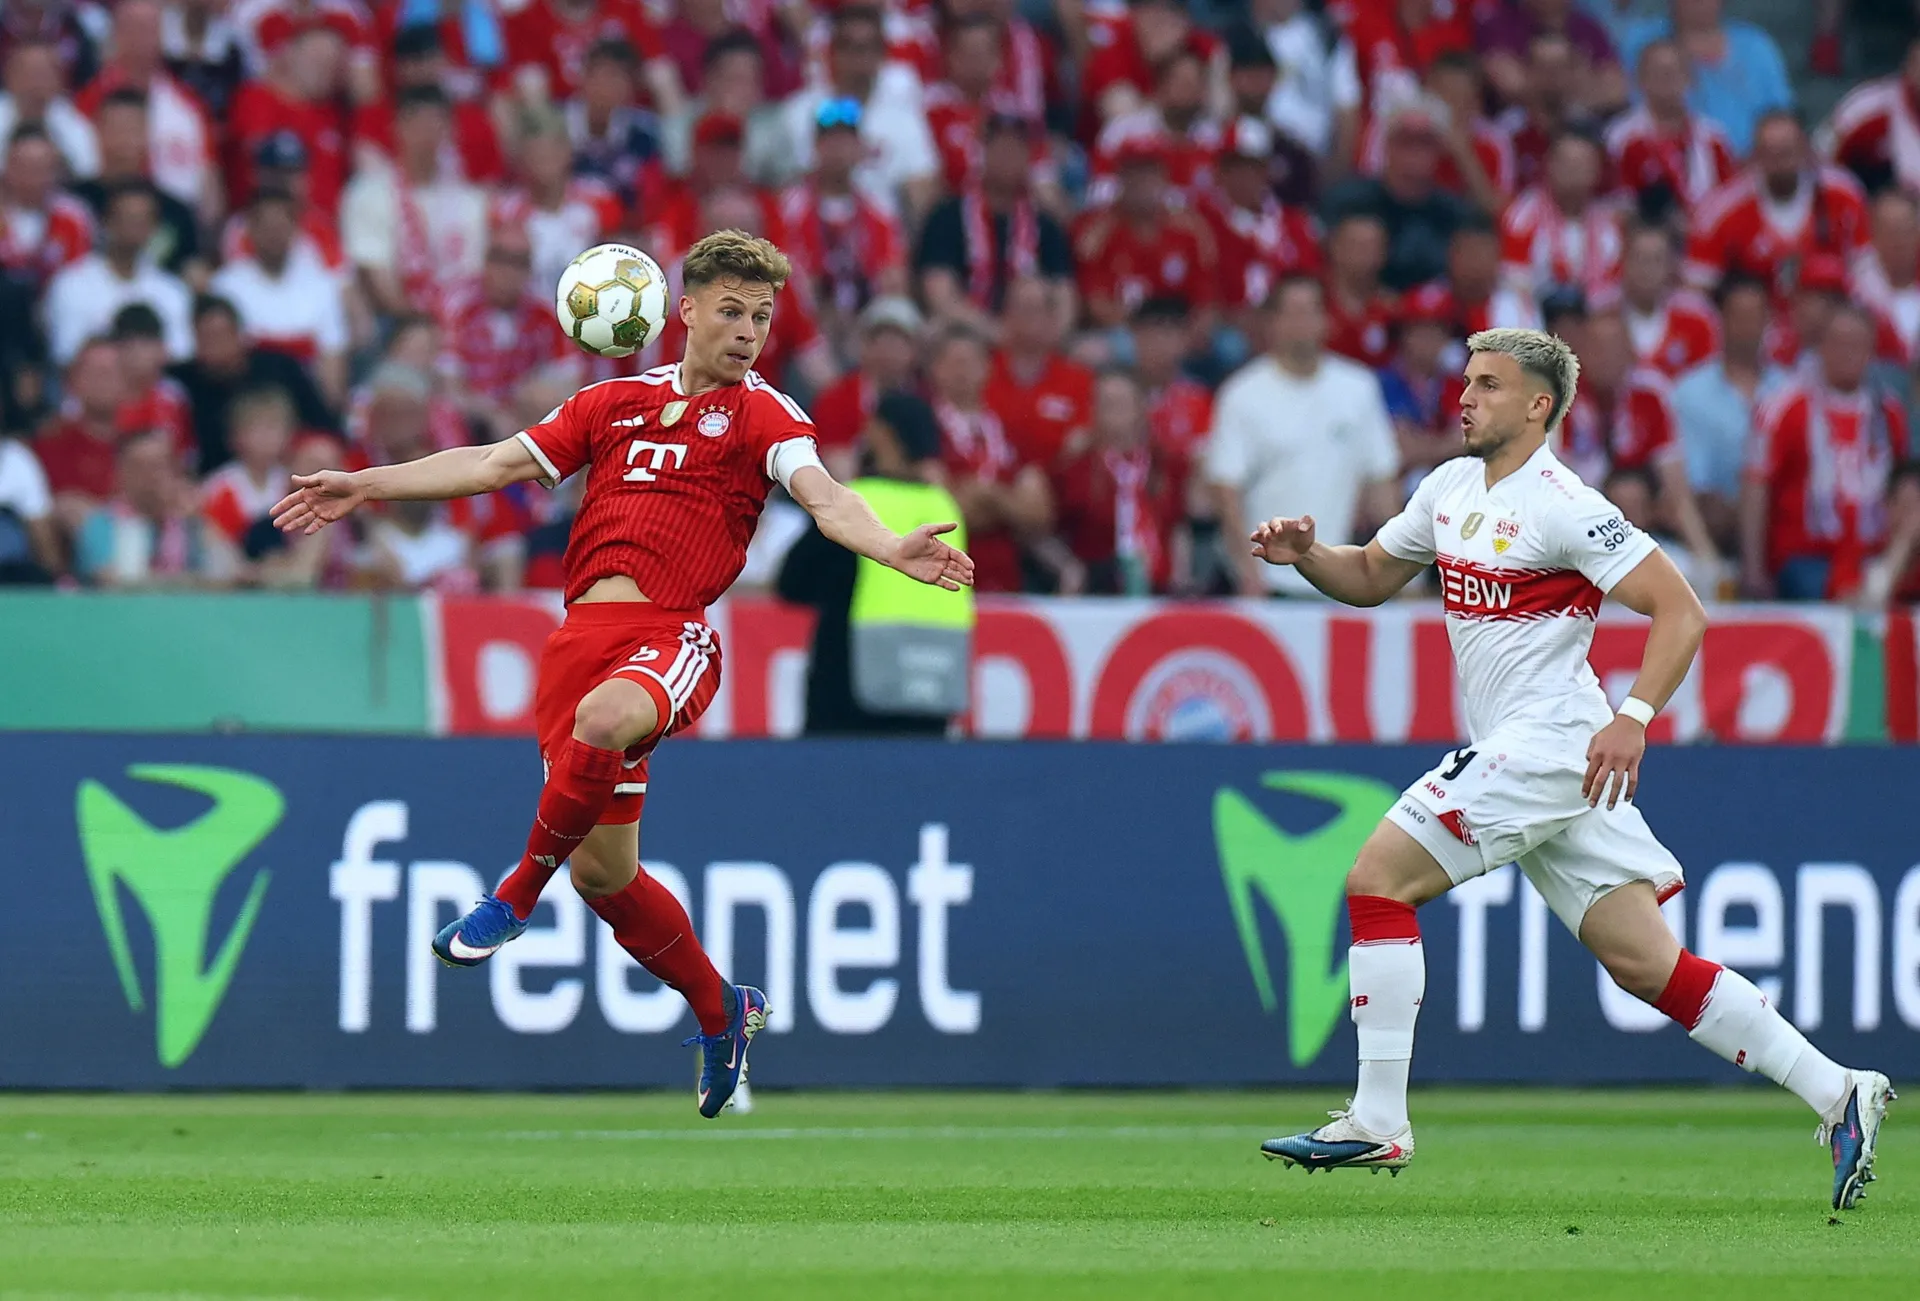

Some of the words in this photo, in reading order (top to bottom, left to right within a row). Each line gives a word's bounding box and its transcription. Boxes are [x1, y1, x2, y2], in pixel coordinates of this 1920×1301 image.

[622, 440, 688, 482] T
[1423, 781, 1446, 800] AKO
[1401, 803, 1426, 824] JAKO
